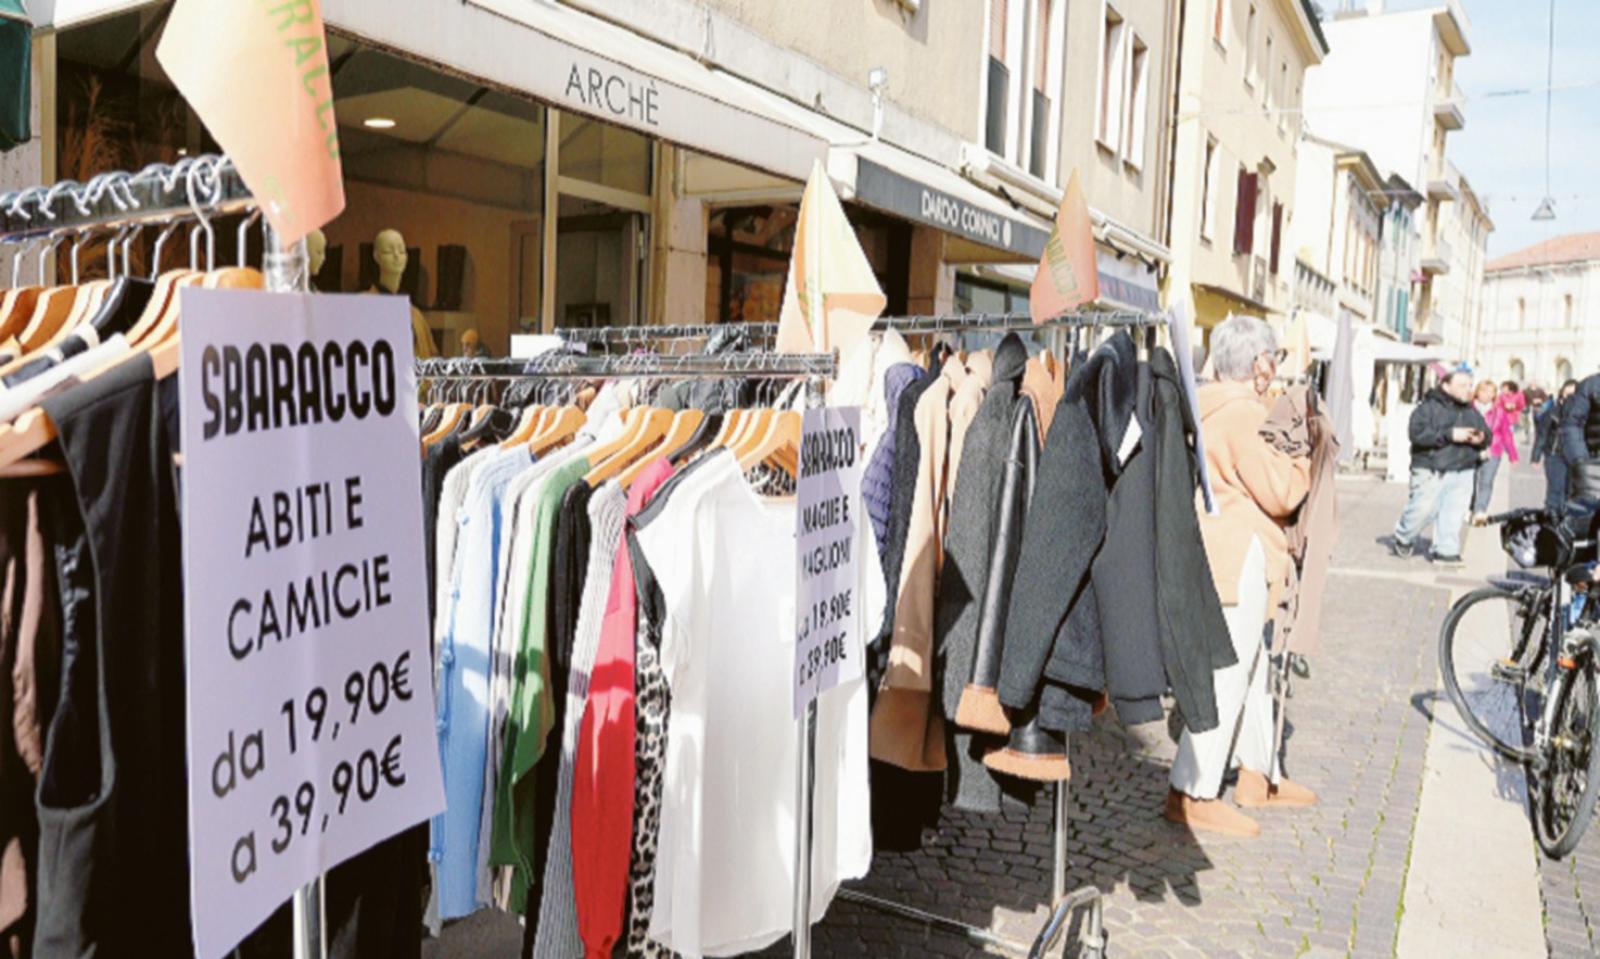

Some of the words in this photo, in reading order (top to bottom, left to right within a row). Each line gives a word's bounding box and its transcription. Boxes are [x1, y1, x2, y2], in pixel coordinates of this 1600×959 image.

[565, 62, 659, 126] ARCHÈ
[202, 339, 396, 441] SBARACCO
[245, 481, 332, 558] ABITI
[345, 475, 364, 530] E
[227, 554, 392, 661] CAMICIE
[211, 728, 265, 798] da
[281, 650, 413, 754] 19,90€
[231, 829, 257, 884] a
[270, 733, 406, 854] 39,90€
